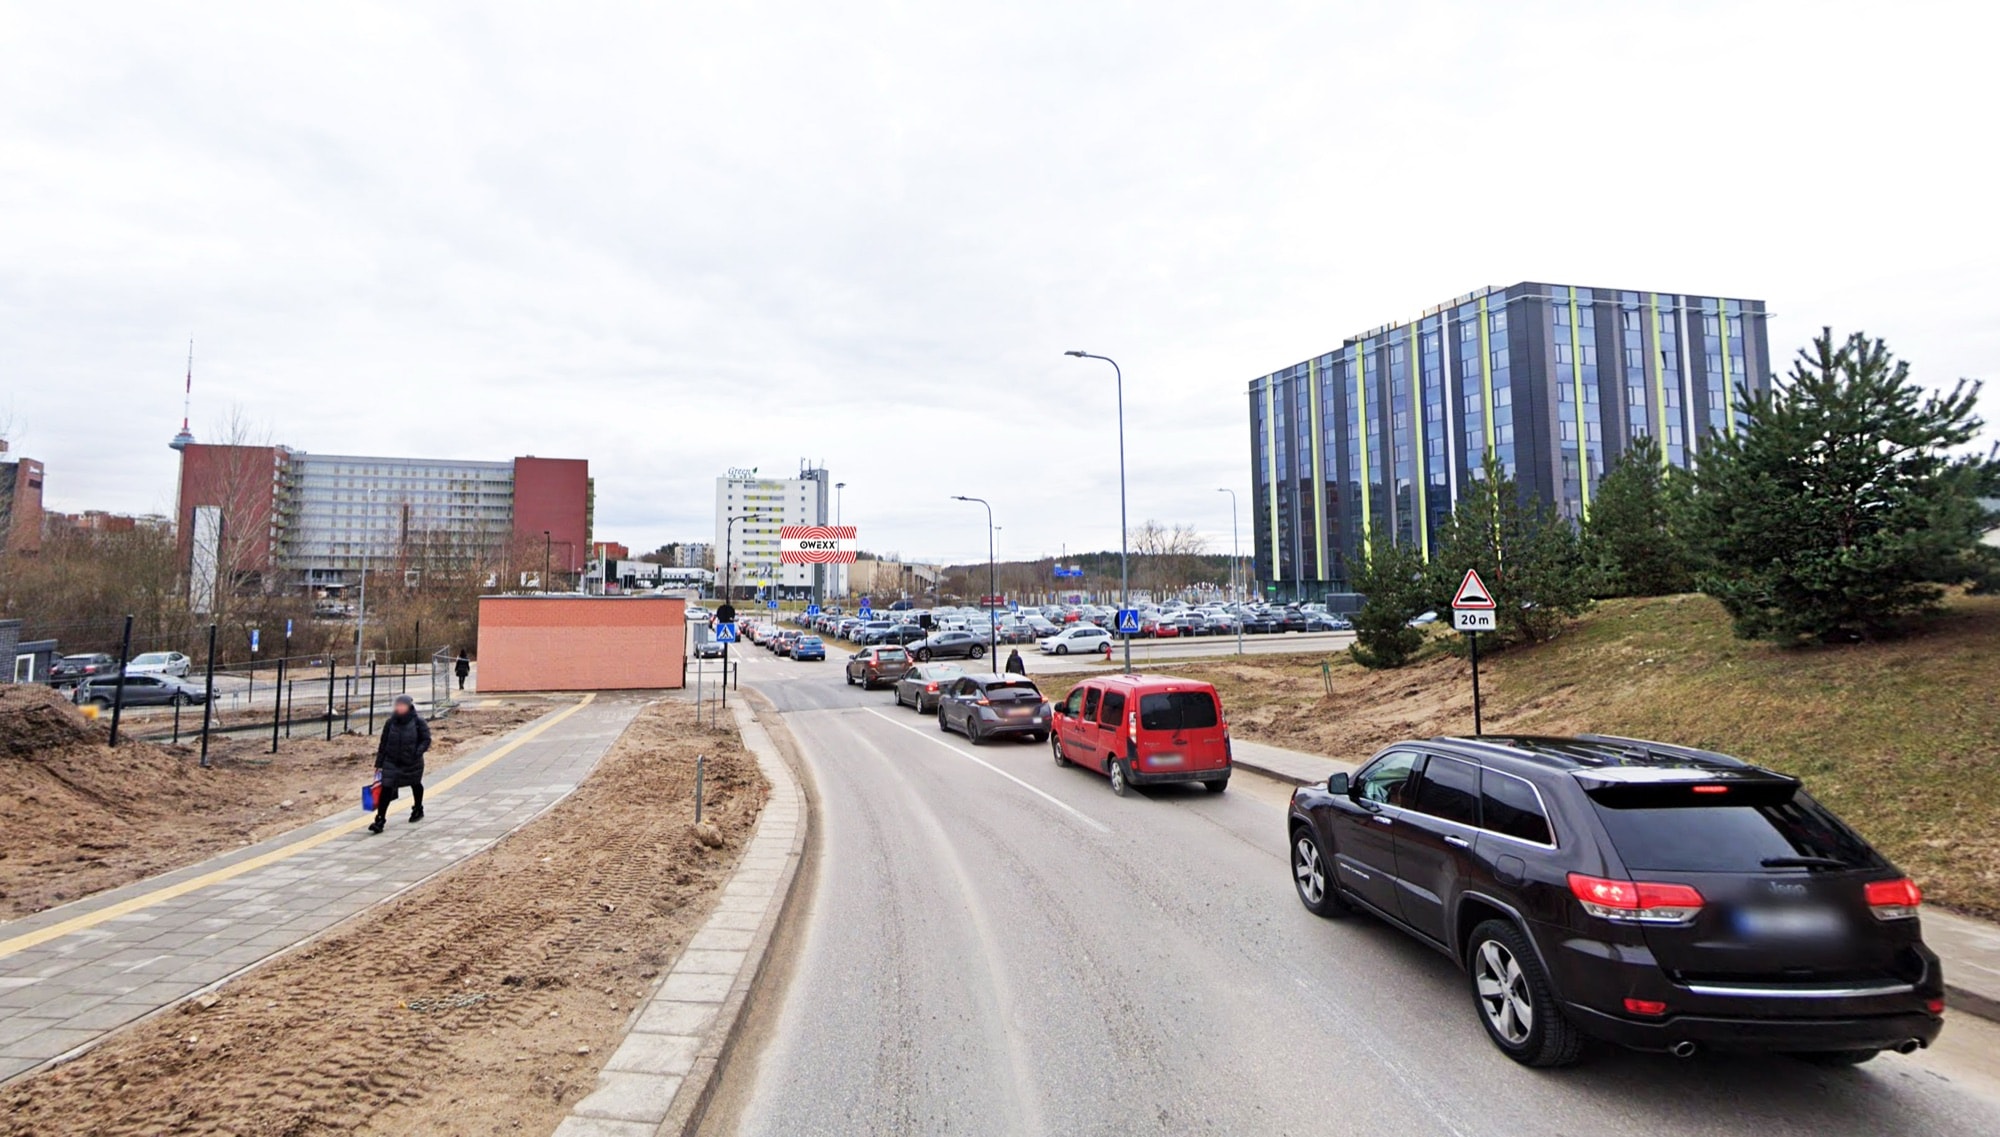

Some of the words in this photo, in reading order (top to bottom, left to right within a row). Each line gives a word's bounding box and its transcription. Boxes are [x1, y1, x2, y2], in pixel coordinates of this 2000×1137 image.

[800, 540, 835, 549] OWEXX
[1461, 614, 1476, 625] 20
[1478, 616, 1489, 625] m
